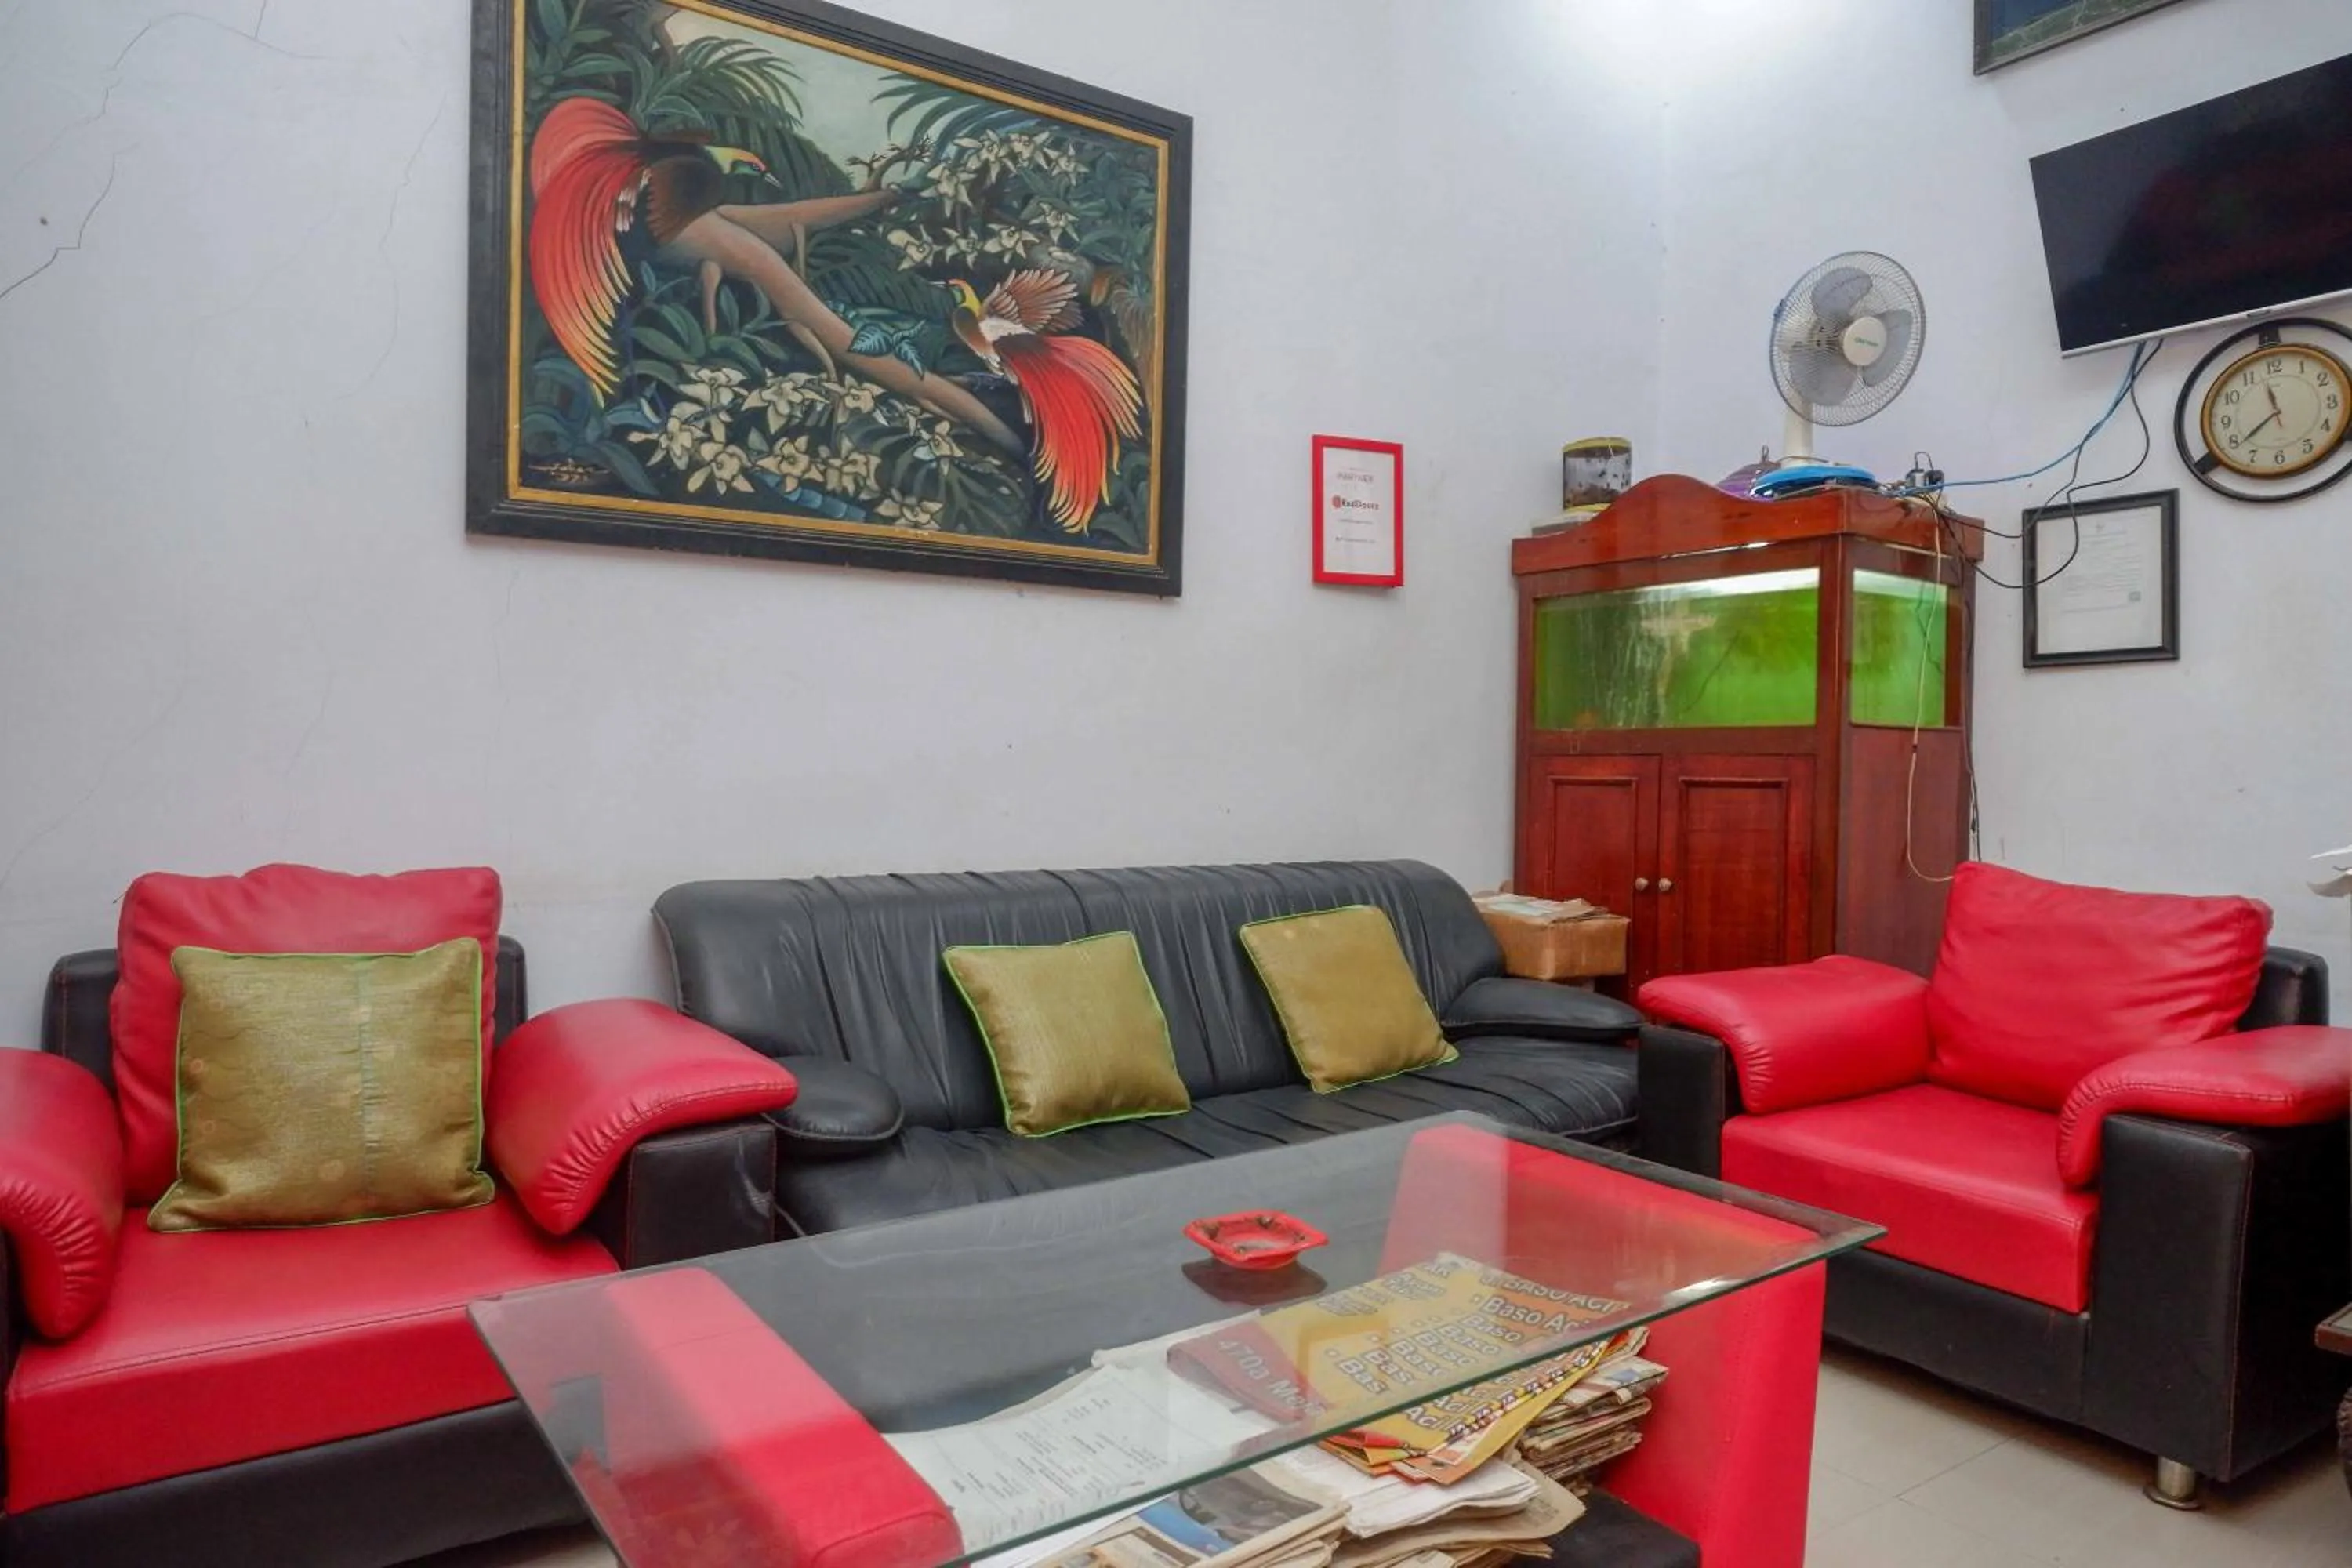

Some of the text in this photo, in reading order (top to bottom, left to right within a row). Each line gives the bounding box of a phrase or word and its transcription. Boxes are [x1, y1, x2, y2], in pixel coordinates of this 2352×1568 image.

[2267, 359, 2282, 375] 12
[2299, 360, 2305, 374] 1
[2243, 372, 2254, 386] 11
[2317, 372, 2329, 387] 2
[2225, 390, 2240, 405] 10
[2327, 394, 2338, 409] 3
[2220, 415, 2231, 430] 9
[2321, 417, 2331, 433] 4
[2229, 434, 2240, 449] 8
[2303, 438, 2313, 454] 5
[2249, 449, 2258, 463] 7
[2274, 450, 2285, 465] 6
[1481, 1295, 1543, 1325] Baso
